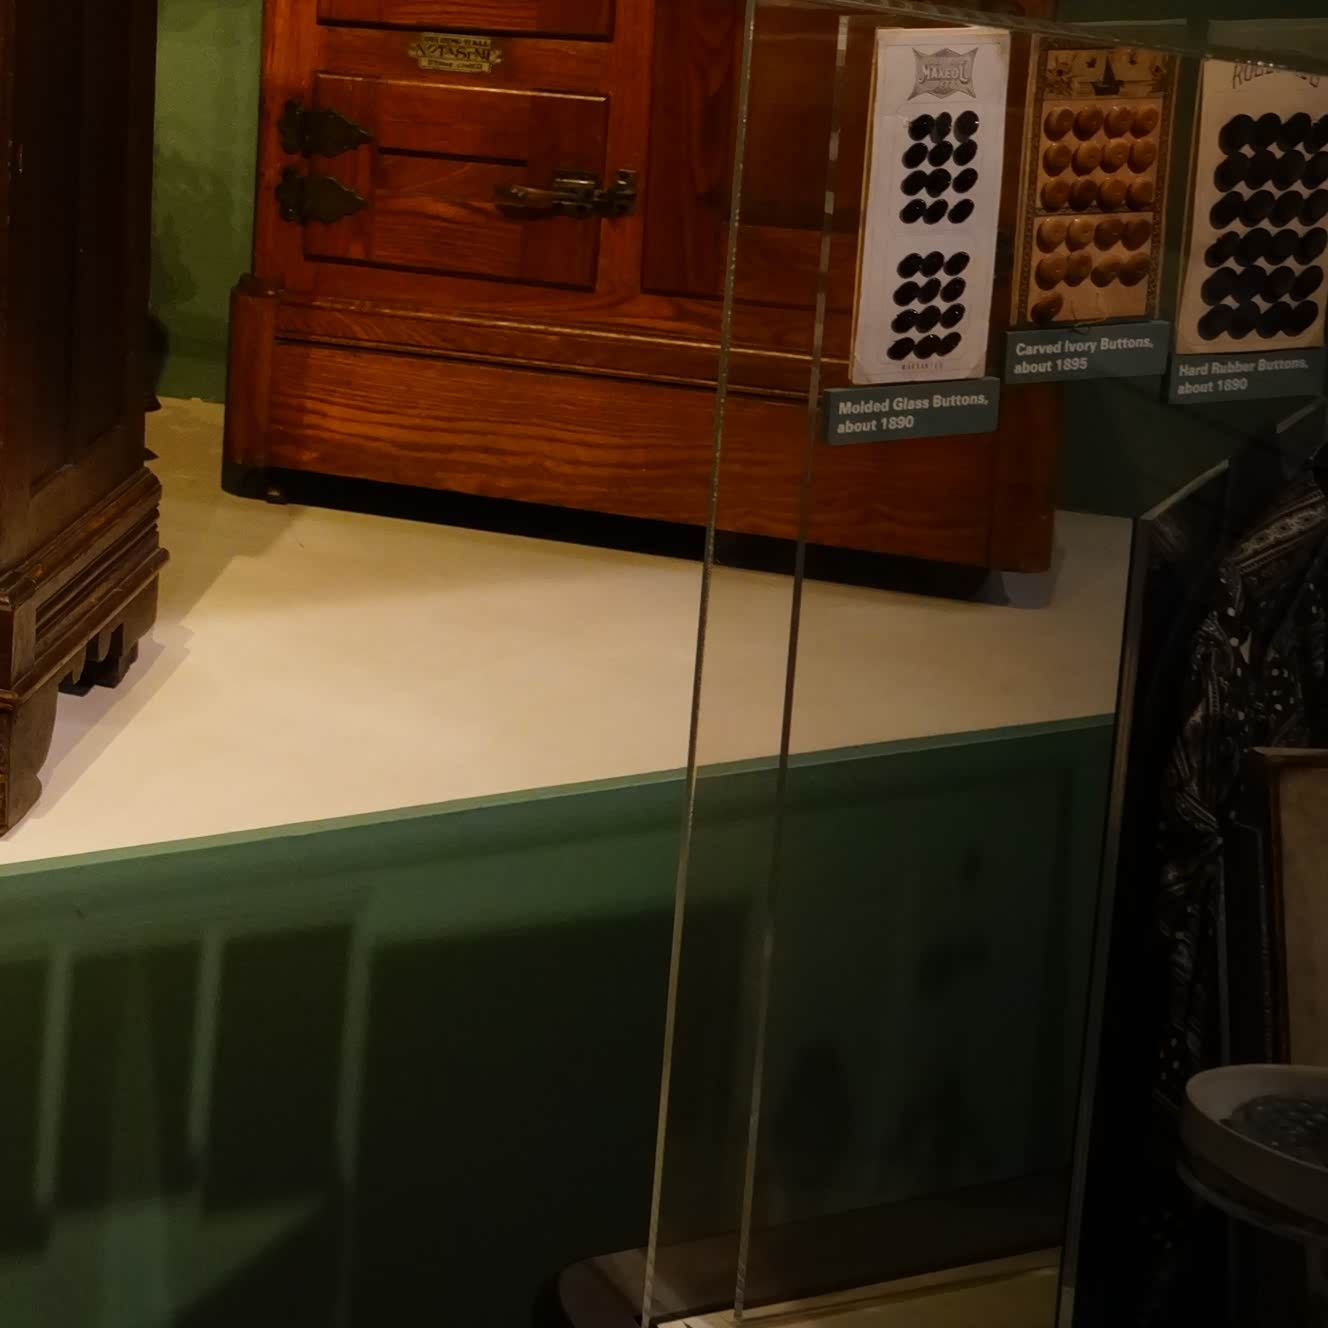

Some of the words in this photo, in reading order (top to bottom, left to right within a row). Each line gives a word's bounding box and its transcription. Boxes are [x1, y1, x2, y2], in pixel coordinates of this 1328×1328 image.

[1016, 342, 1061, 356] Carved
[1065, 340, 1097, 354] Ivory
[1100, 337, 1153, 350] Buttons,
[1014, 361, 1052, 374] about
[1056, 358, 1088, 371] 1895
[1178, 363, 1209, 376] Hard
[1211, 361, 1256, 374] Rubber
[1177, 382, 1214, 394] about
[839, 398, 890, 415] Molded
[893, 397, 929, 411] Glass
[932, 394, 989, 408] Buttons,
[837, 420, 877, 434] about
[881, 415, 915, 430] 1890
